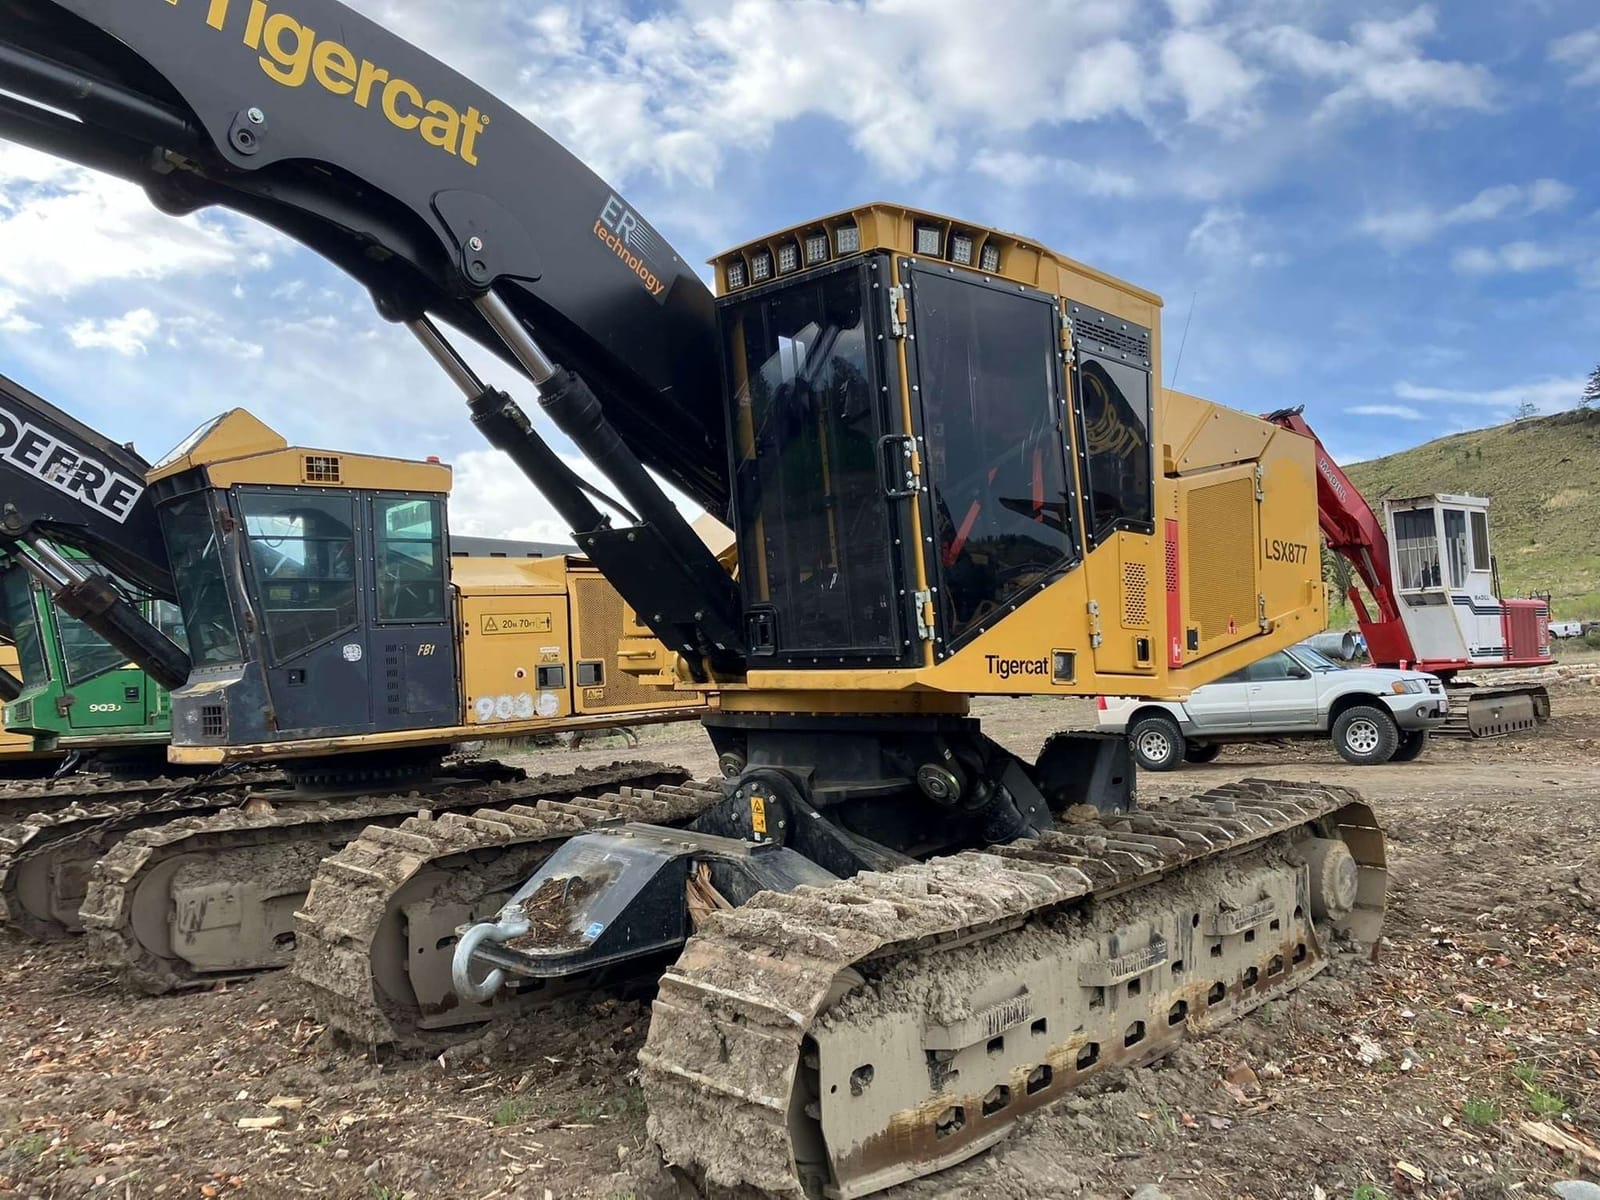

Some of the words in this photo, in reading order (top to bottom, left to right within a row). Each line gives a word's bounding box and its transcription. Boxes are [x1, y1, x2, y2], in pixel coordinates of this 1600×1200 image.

[600, 195, 637, 243] ER
[593, 219, 665, 295] technology
[1265, 538, 1308, 565] LSX877
[417, 643, 435, 656] FB1
[984, 655, 1049, 679] Tigercat
